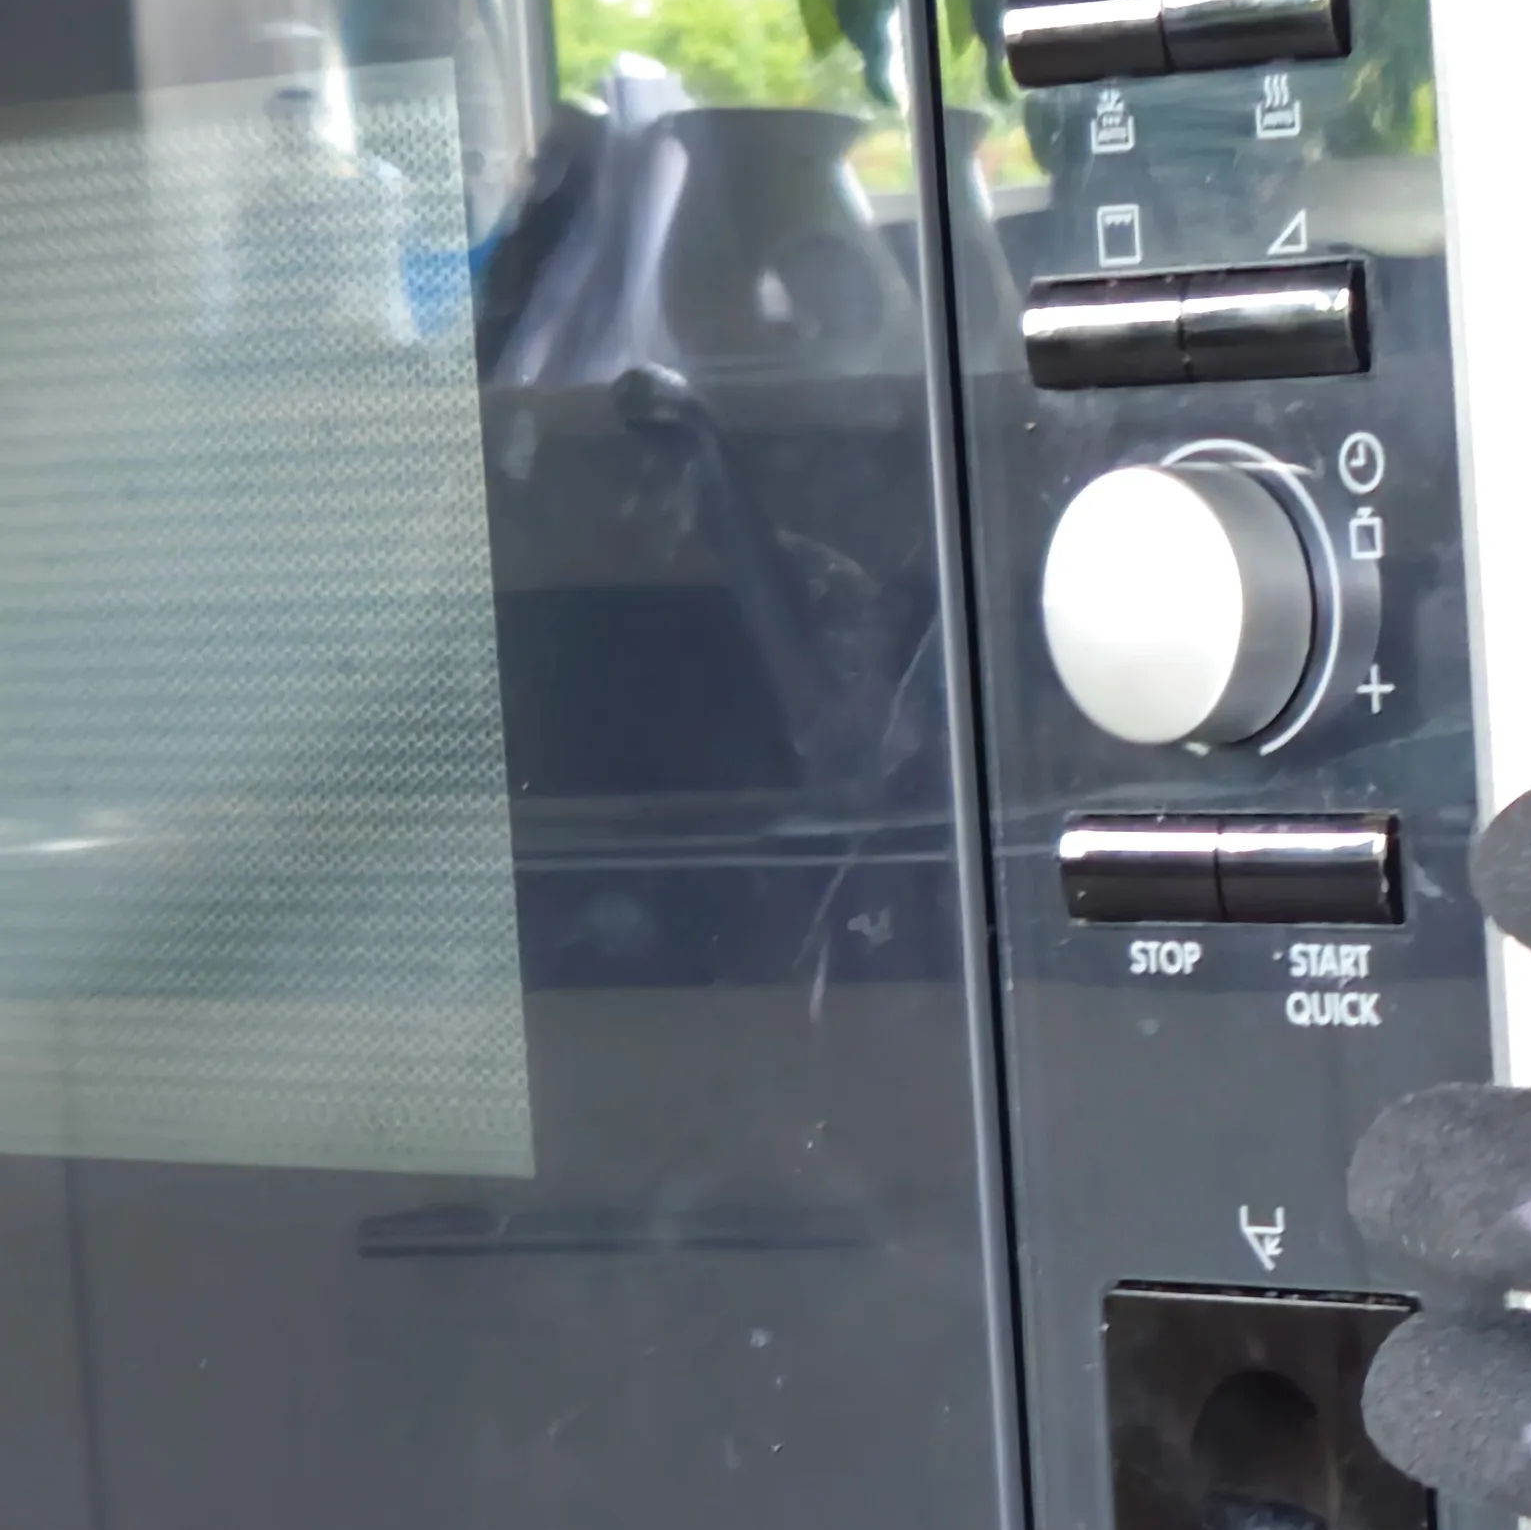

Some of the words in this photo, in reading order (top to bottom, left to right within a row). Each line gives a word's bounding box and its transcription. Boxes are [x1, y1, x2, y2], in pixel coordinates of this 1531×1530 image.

[1130, 940, 1202, 976] STOP
[1287, 942, 1372, 979] START
[1284, 990, 1383, 1028] QUICK
